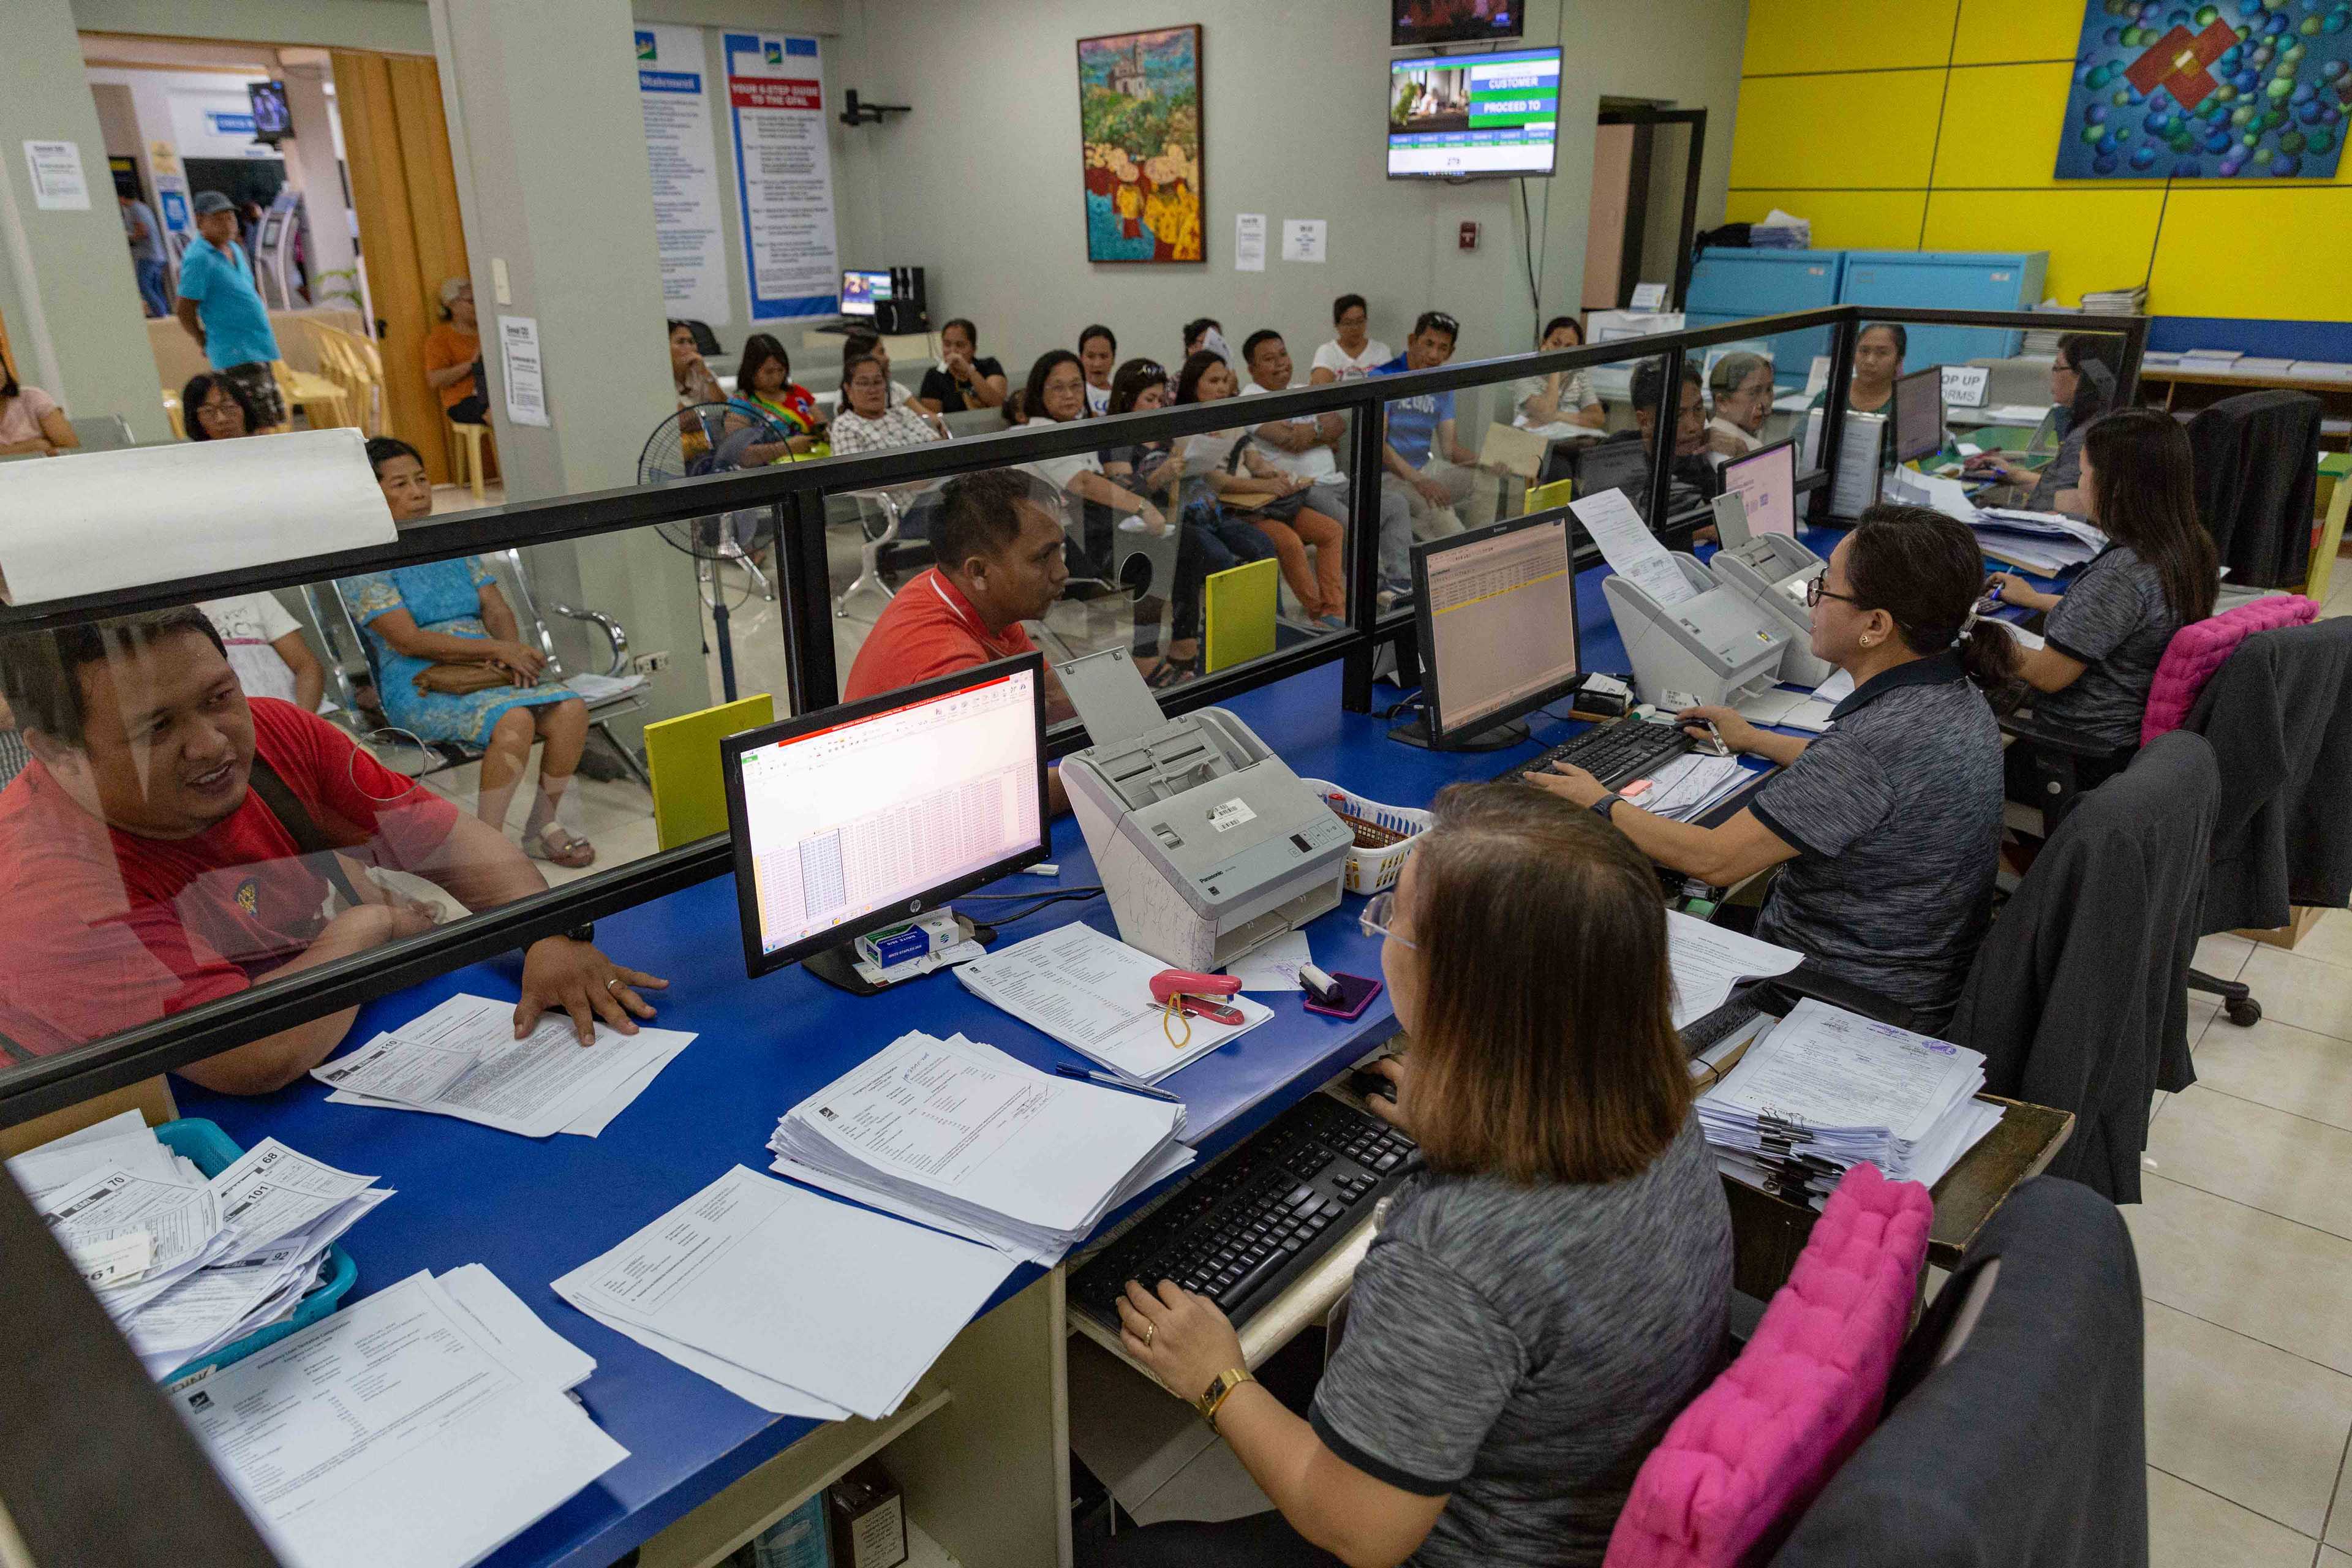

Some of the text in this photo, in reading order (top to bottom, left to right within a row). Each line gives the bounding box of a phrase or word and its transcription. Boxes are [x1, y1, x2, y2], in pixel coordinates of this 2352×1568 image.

[1489, 77, 1539, 89] CUSTOMER
[1483, 100, 1541, 114] PROCEED TO
[1962, 374, 1981, 387] UP
[1199, 870, 1224, 883] Panasonic
[911, 900, 921, 913] hp
[899, 947, 915, 956] STAPLES
[381, 1039, 398, 1051] 110
[262, 1152, 277, 1163] 68
[107, 1177, 125, 1186] 70
[248, 1186, 269, 1199] 101
[72, 1197, 98, 1211] EML
[272, 1251, 289, 1261] 92
